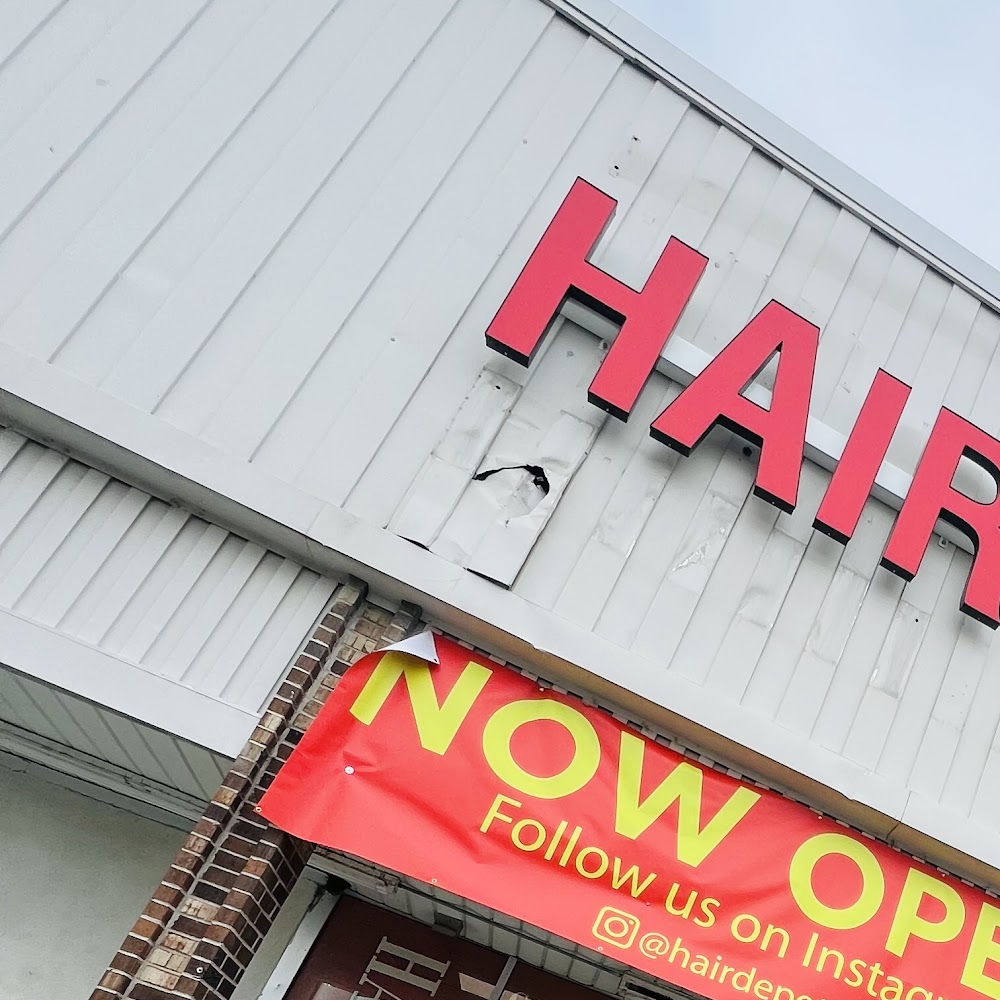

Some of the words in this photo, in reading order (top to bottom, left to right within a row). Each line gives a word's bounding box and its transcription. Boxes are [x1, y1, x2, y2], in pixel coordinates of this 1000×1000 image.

[349, 650, 762, 868] NOW
[479, 794, 659, 901] Follow
[665, 879, 721, 928] us
[732, 909, 790, 957] on
